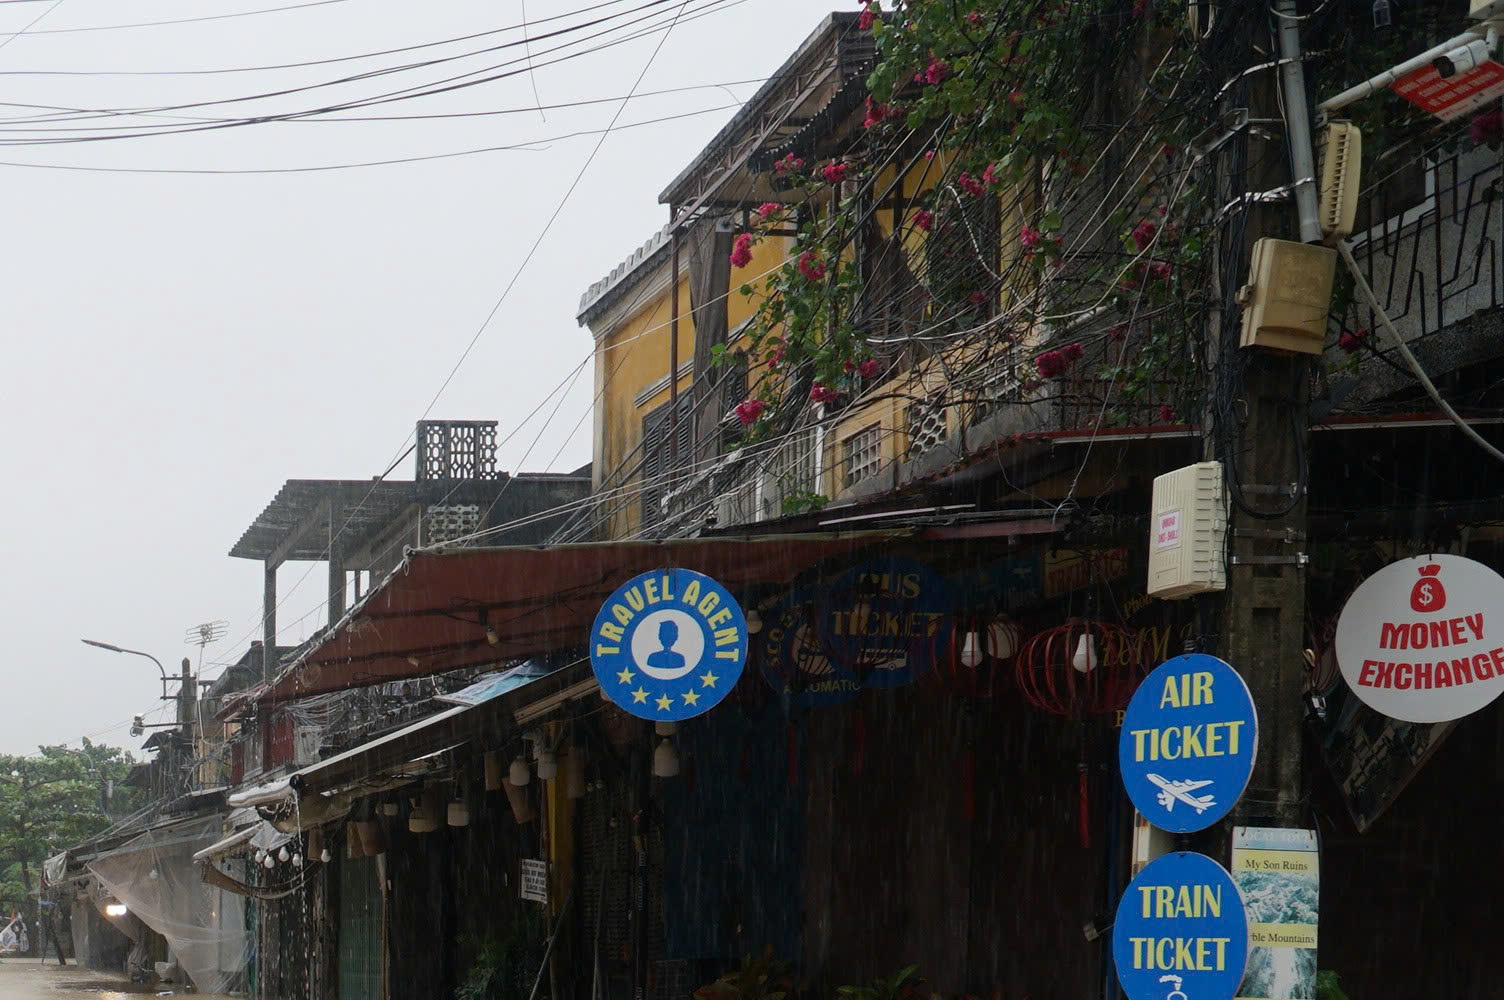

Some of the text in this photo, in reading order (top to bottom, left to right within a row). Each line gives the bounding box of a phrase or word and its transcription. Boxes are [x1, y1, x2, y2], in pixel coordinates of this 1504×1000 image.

[597, 576, 673, 657] TRAVEL
[683, 580, 739, 662] AGENT
[1380, 613, 1484, 650] MONEY
[1358, 647, 1504, 690] EXCHANGE
[1160, 672, 1214, 709] AIR
[1130, 720, 1245, 762] TICKET
[1245, 859, 1308, 871] My Son Ruins
[1138, 885, 1221, 919] TRAIN
[1129, 937, 1231, 971] TICKET
[1268, 933, 1315, 944] Mountains
